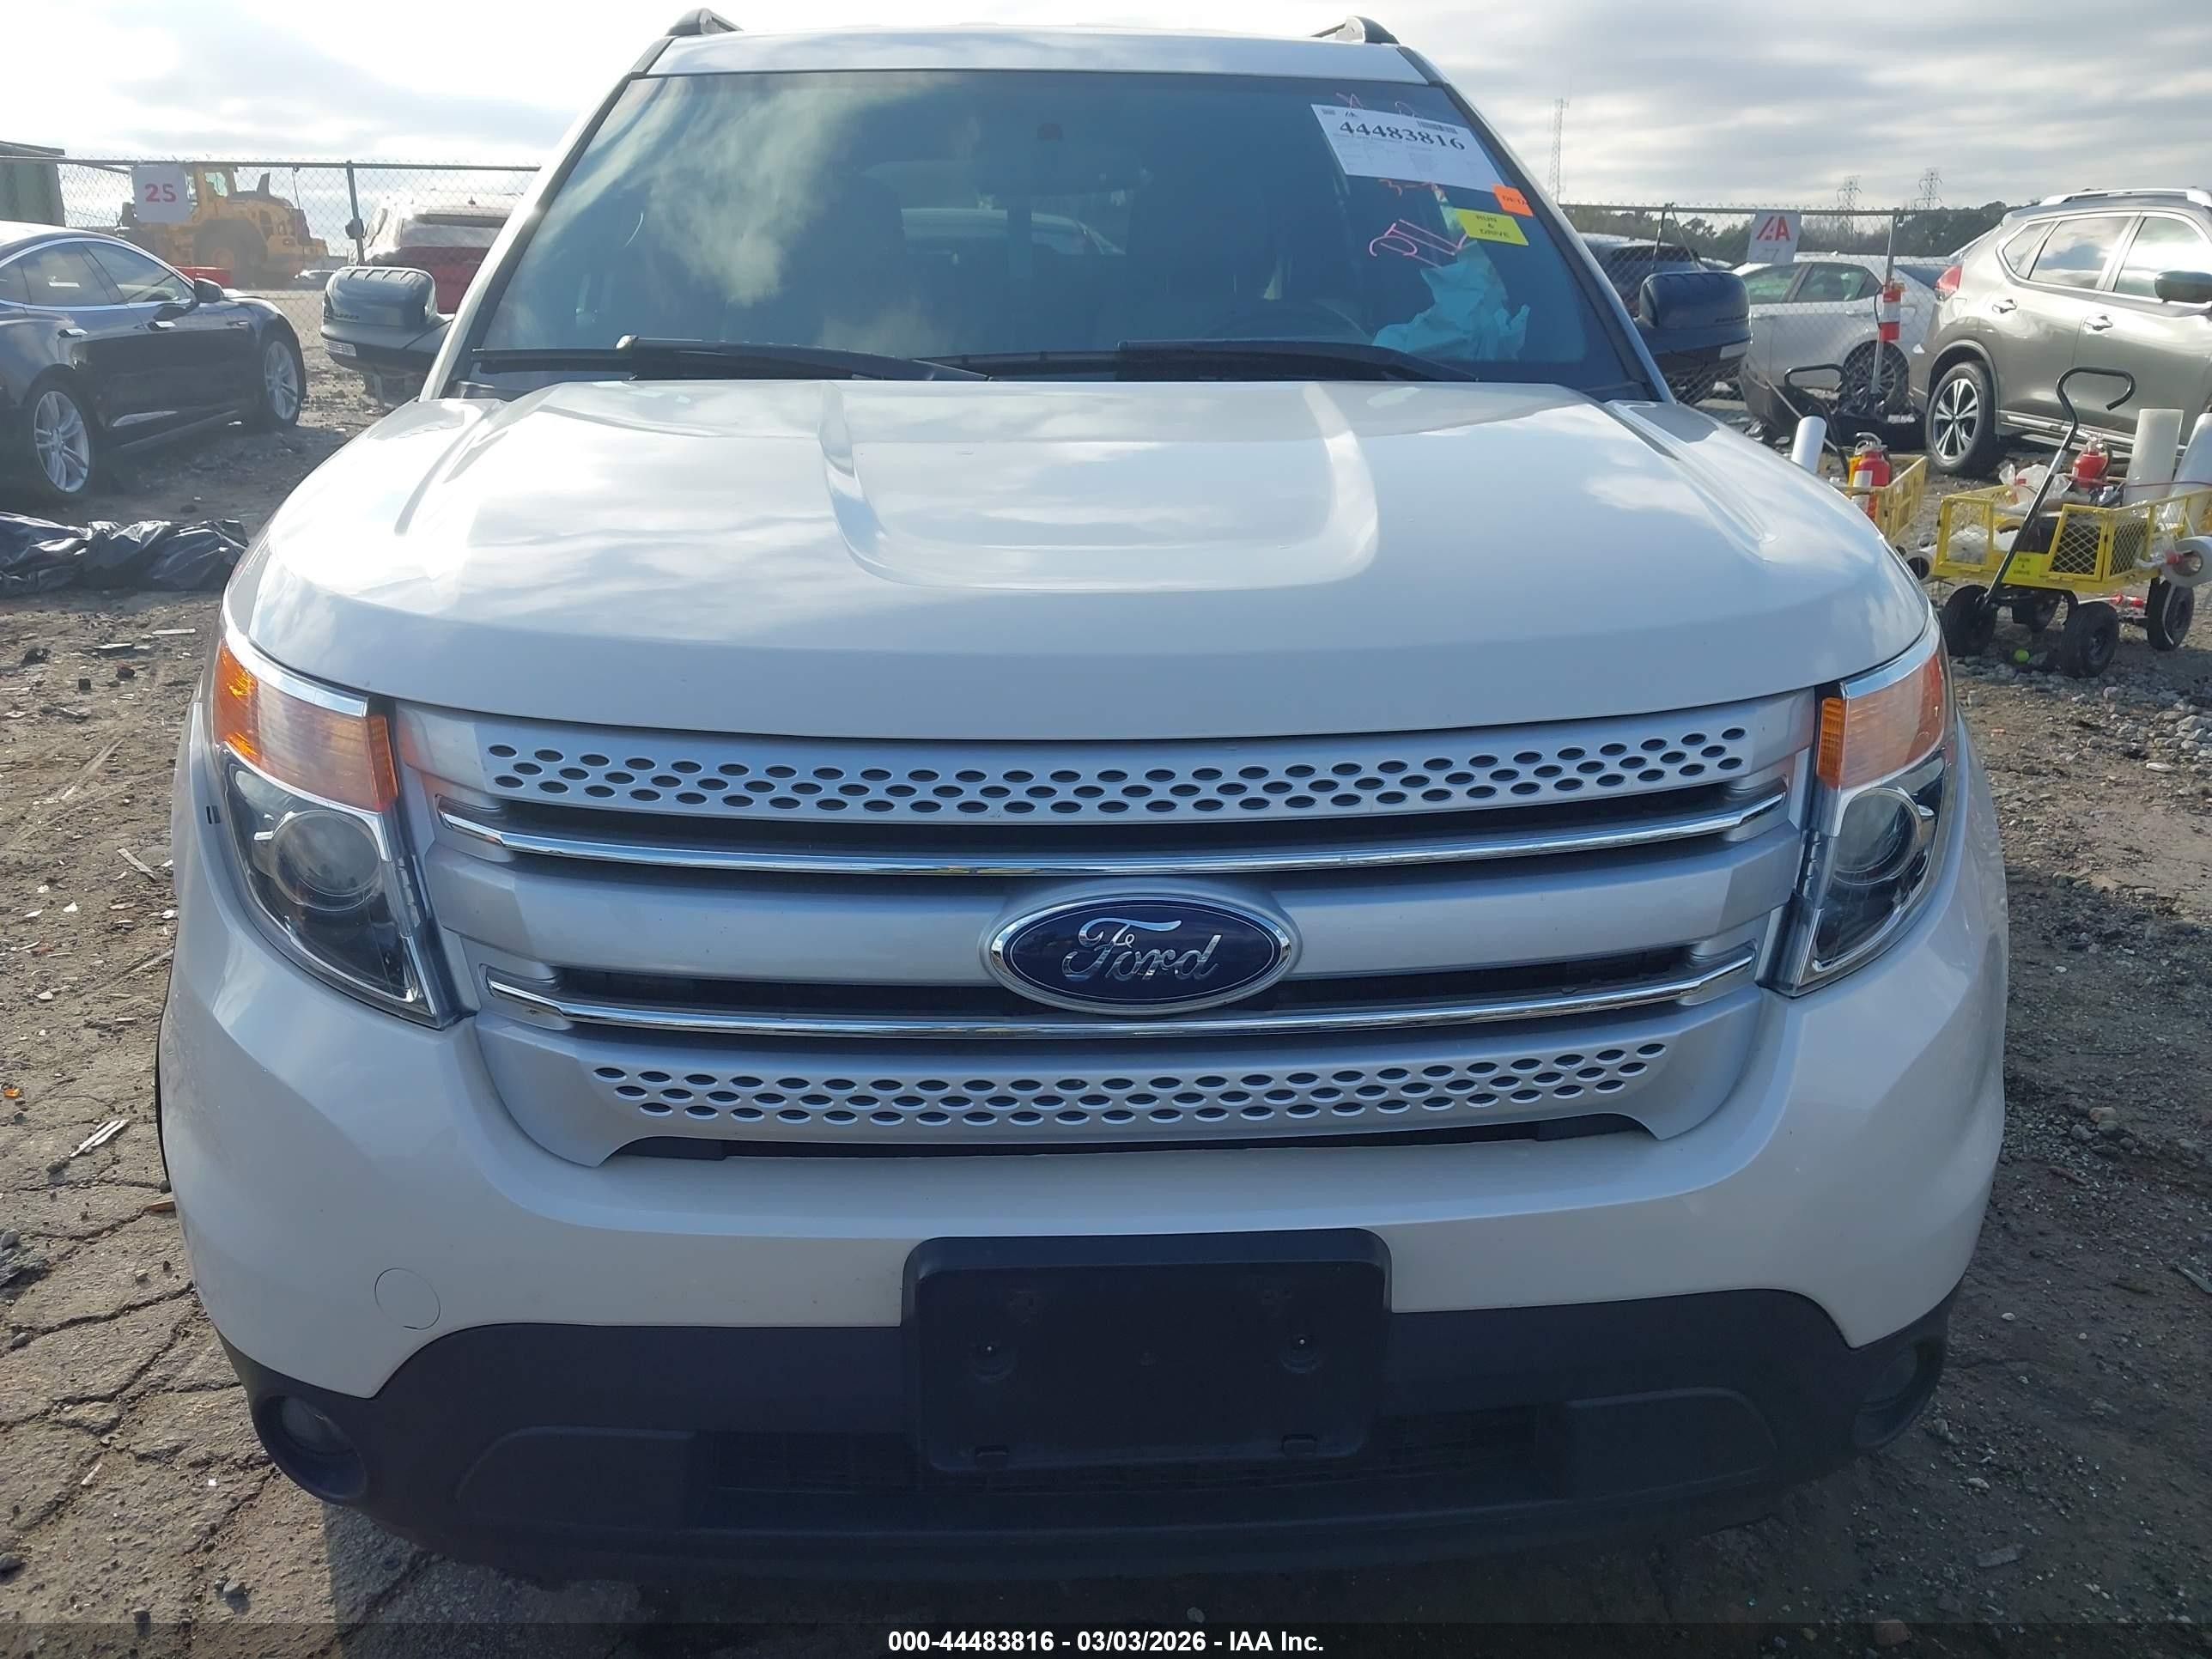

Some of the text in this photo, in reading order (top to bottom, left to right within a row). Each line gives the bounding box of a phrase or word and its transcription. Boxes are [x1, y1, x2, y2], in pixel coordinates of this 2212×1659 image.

[1340, 121, 1466, 150] 44483816
[144, 183, 177, 203] 25
[1061, 917, 1222, 982] Ford
